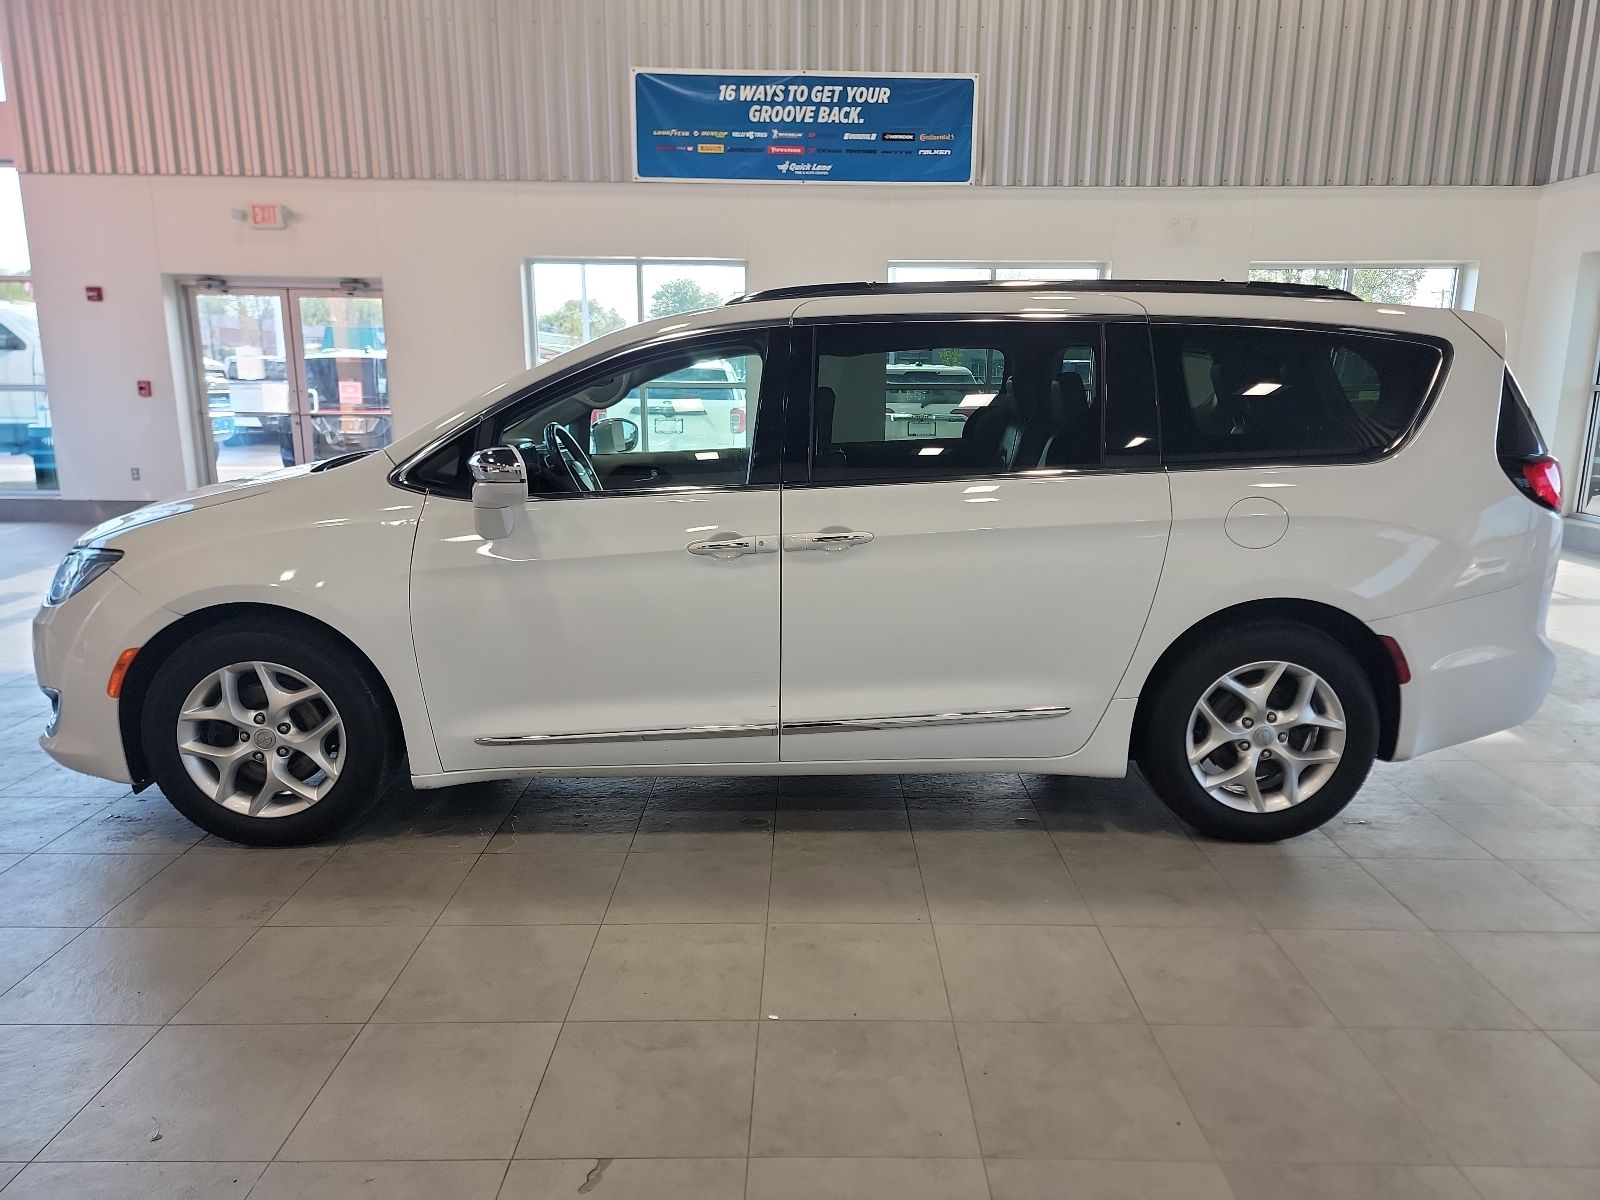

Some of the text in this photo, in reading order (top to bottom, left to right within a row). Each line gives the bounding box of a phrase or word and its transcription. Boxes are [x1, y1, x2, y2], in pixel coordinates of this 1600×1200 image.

[718, 84, 891, 104] 16 WAYS TO GET YOUR
[749, 105, 865, 124] GROOVE BACK.
[788, 163, 811, 172] Quick
[252, 204, 277, 225] EXIT
